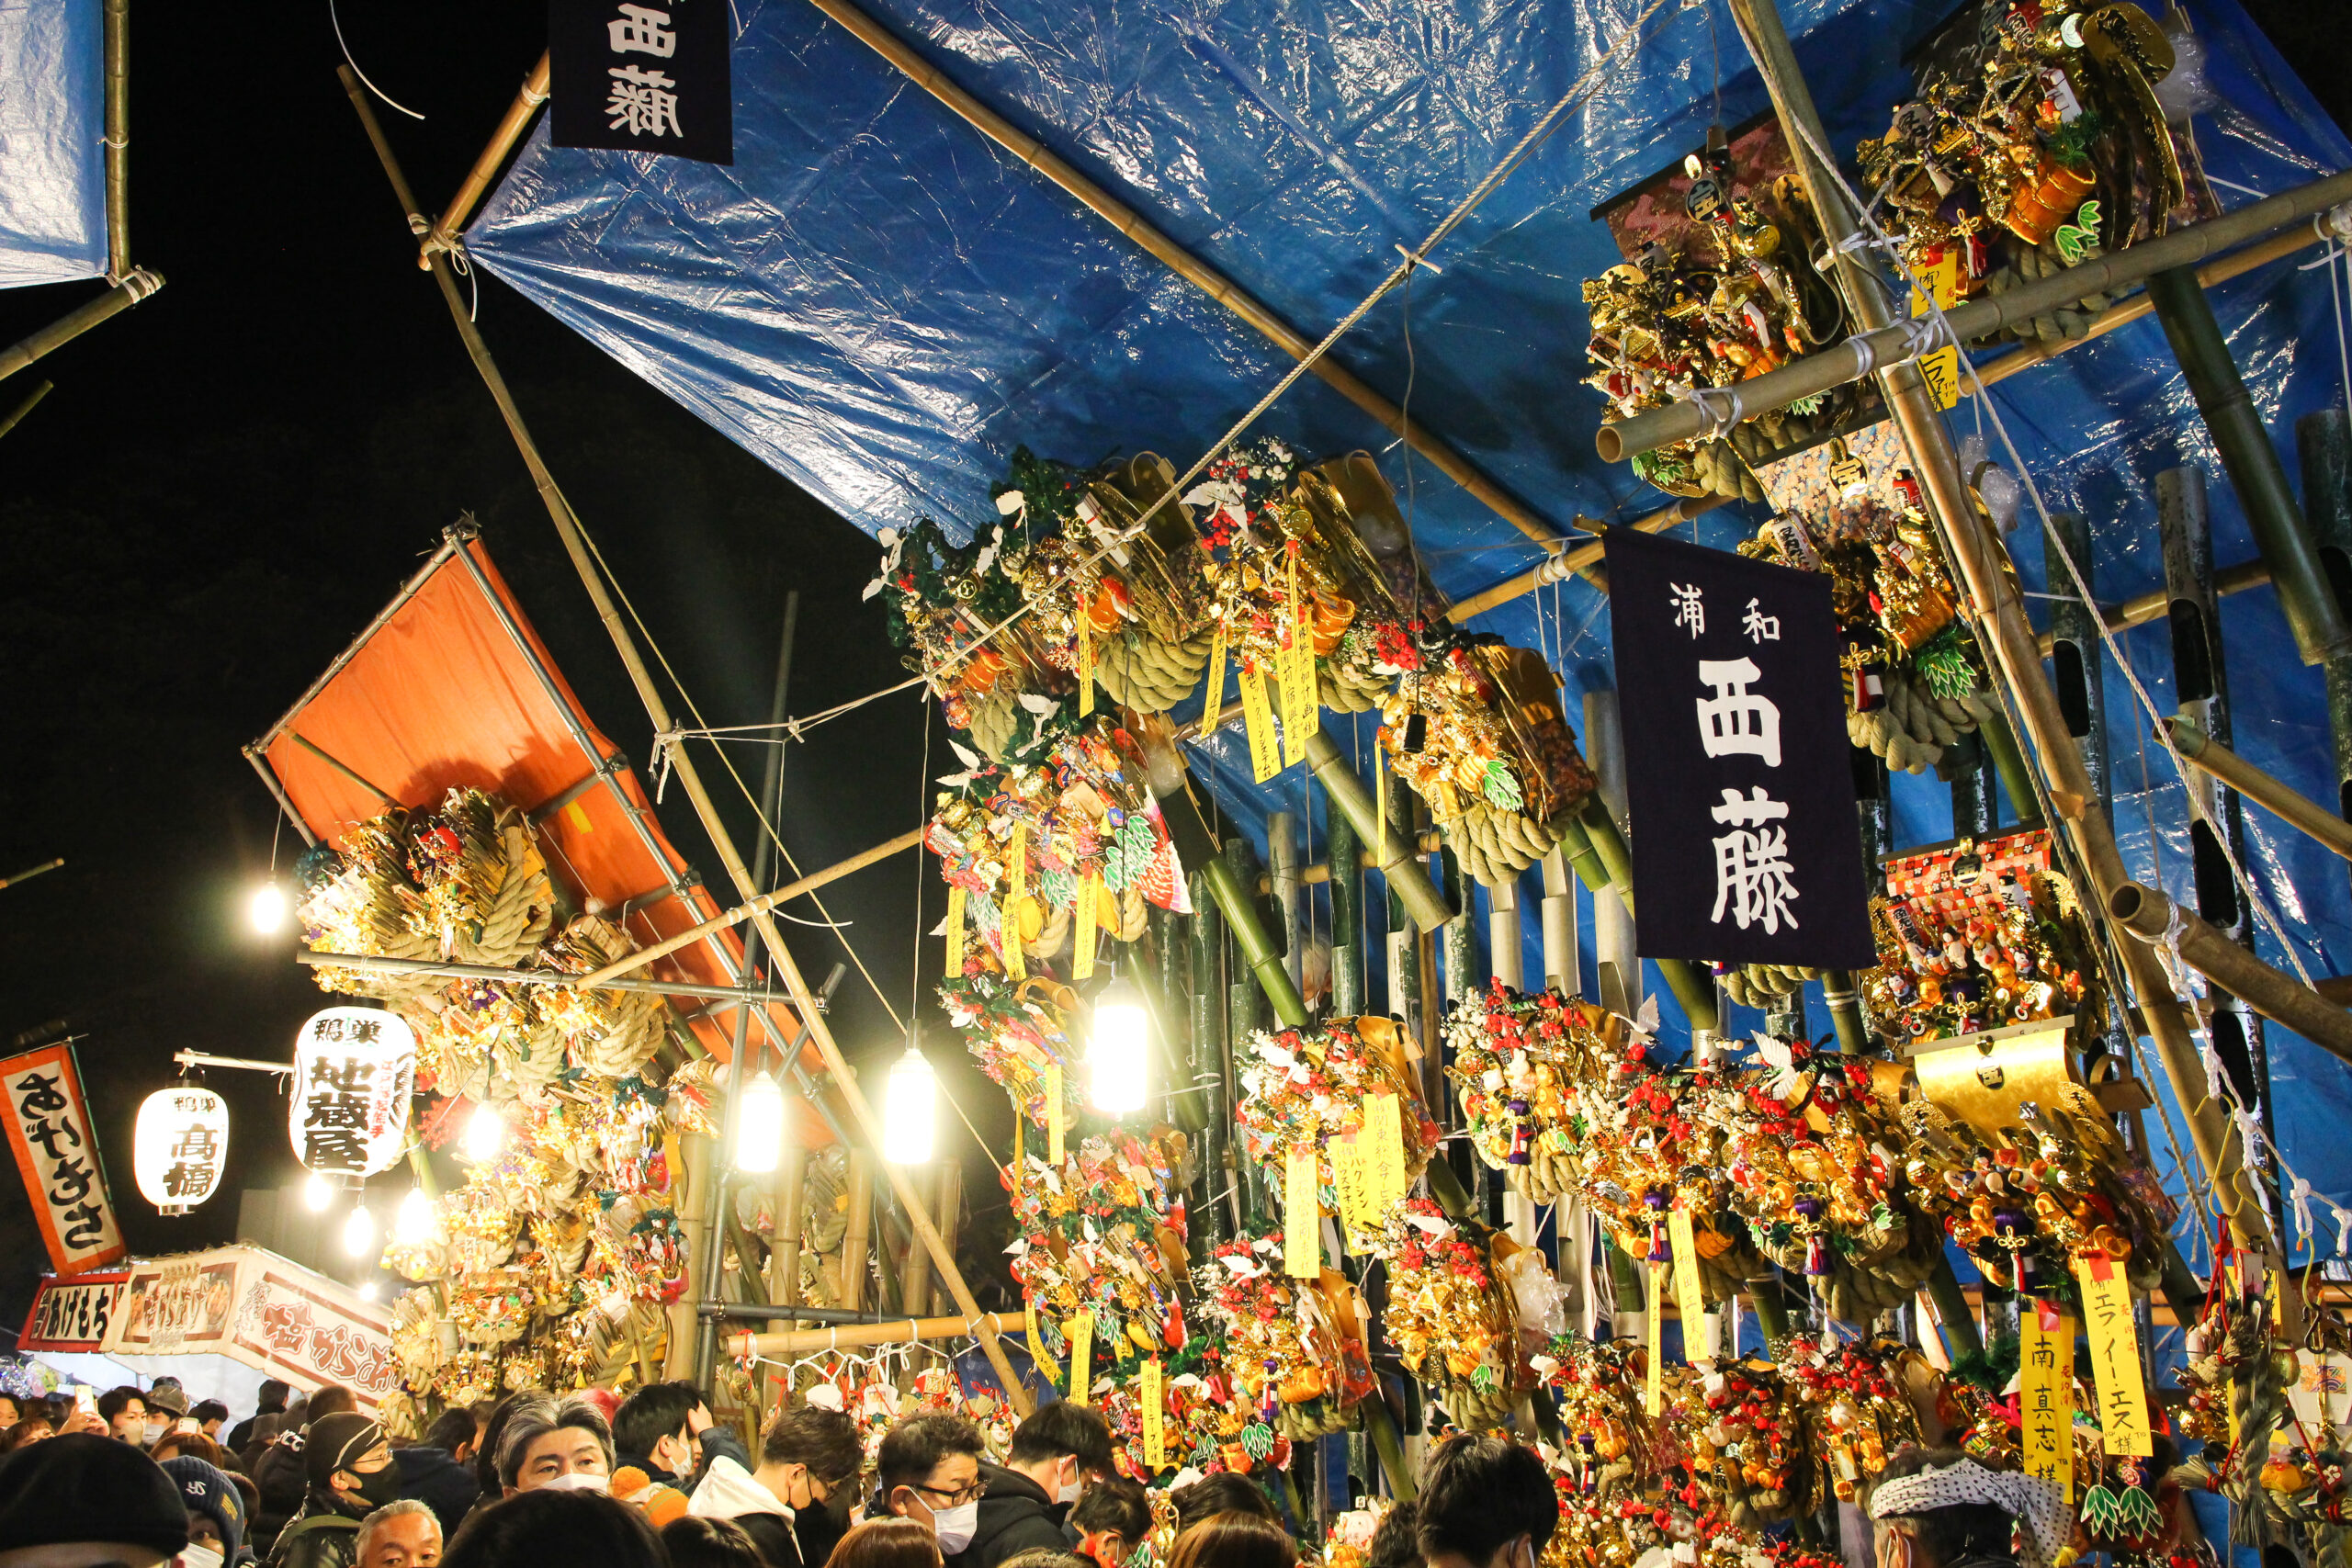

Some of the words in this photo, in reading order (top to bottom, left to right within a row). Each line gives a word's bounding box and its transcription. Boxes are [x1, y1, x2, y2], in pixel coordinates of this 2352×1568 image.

[1669, 581, 1781, 645] 浦和
[1696, 656, 1799, 936] 西藤
[304, 1056, 377, 1173] 地蔵屋
[46, 1287, 109, 1339] あげもち
